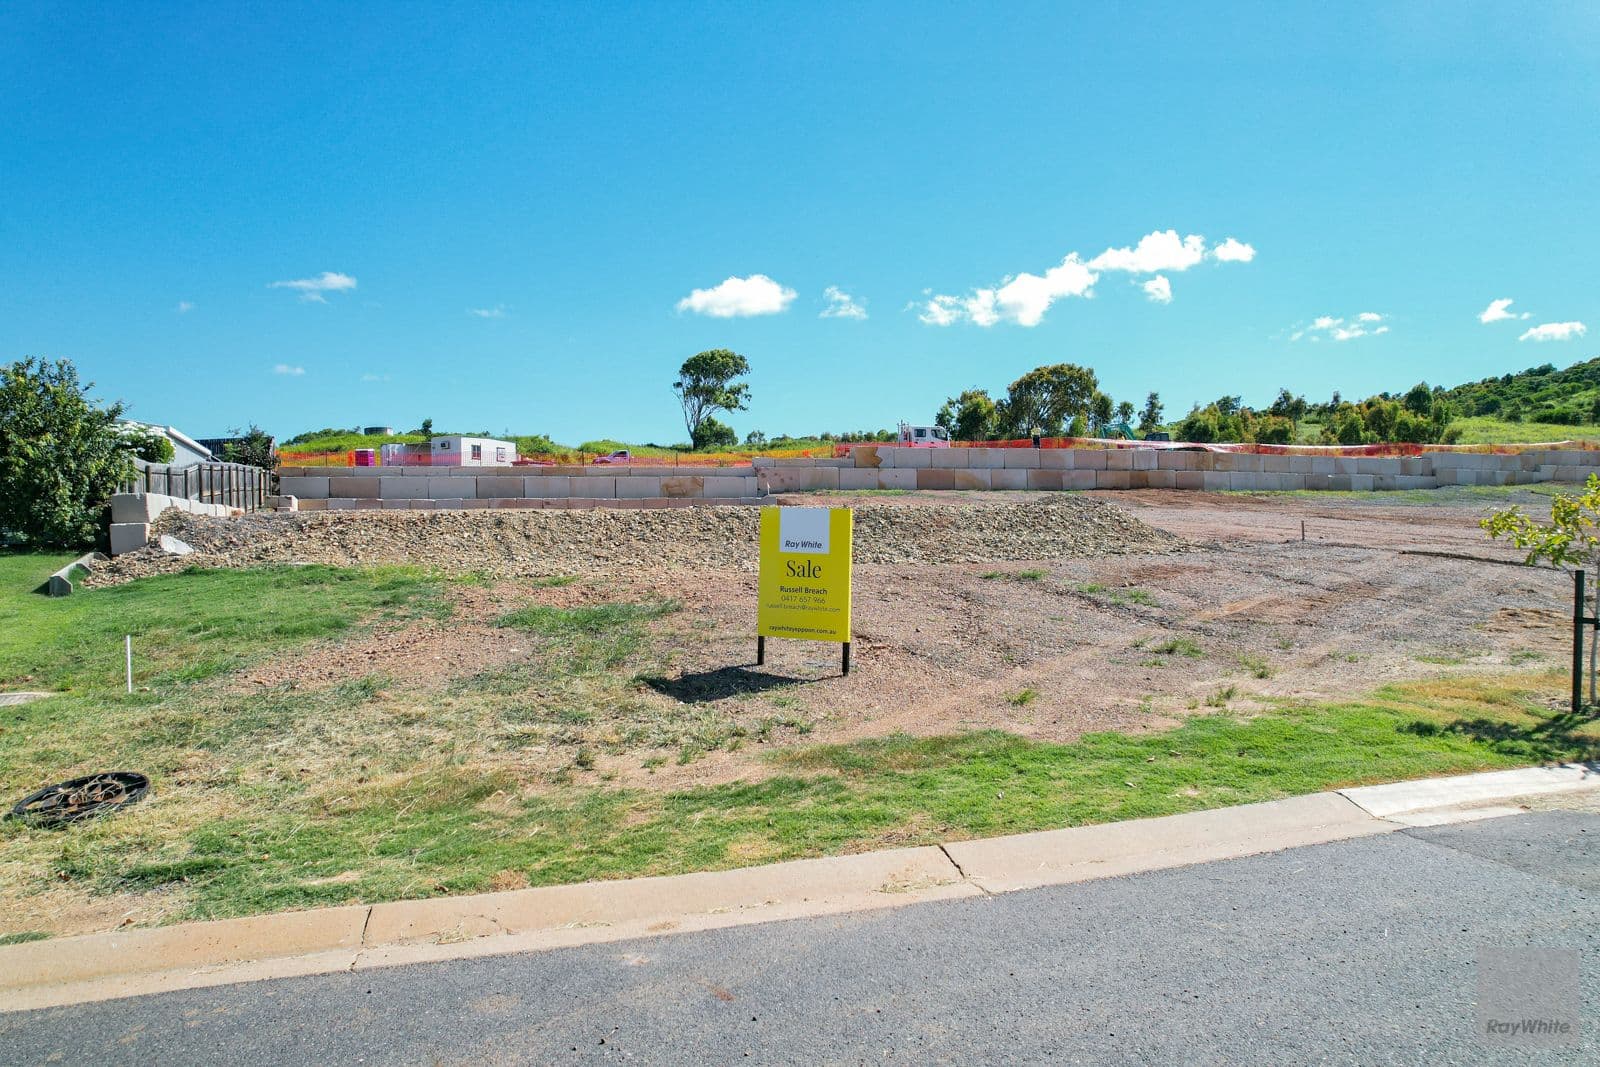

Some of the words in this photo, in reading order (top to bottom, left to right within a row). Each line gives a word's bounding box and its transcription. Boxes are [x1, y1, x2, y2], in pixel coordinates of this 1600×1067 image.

[785, 540, 800, 549] Ray
[801, 541, 822, 549] White
[786, 559, 822, 579] Sale
[780, 585, 803, 593] Russell
[804, 586, 828, 595] Breach
